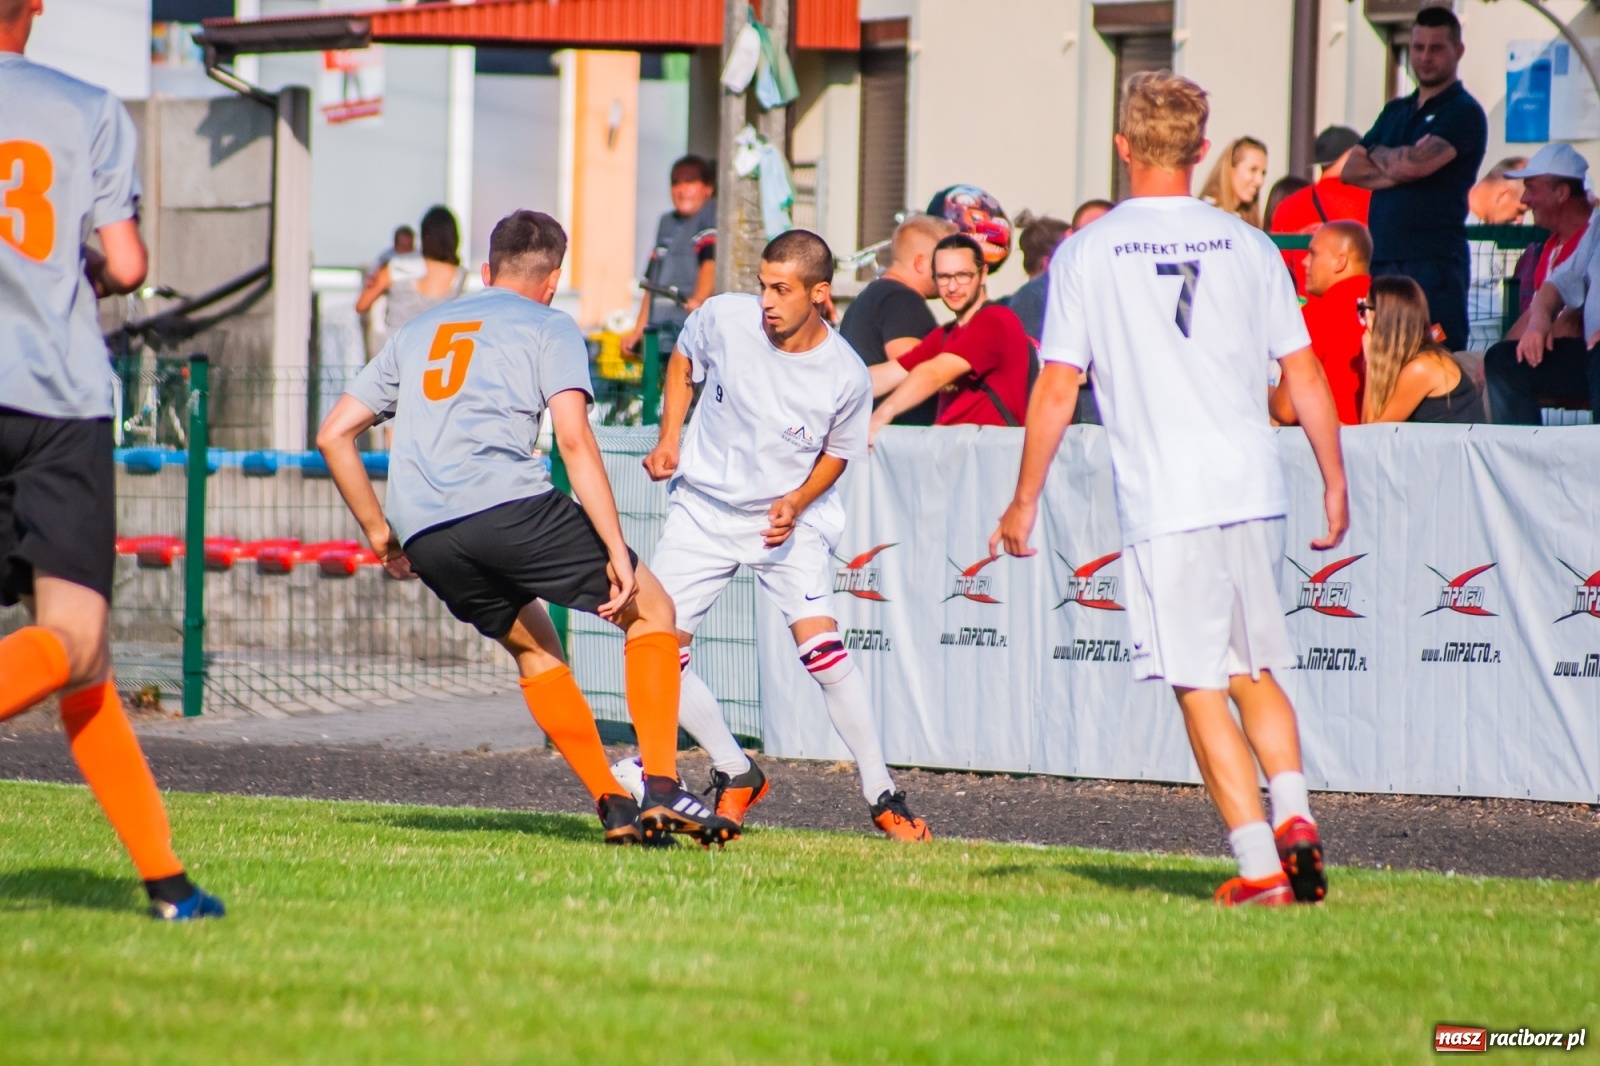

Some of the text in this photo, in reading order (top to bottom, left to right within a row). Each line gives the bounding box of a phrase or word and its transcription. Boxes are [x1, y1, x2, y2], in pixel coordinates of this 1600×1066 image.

[0, 139, 55, 262] 3
[1114, 239, 1233, 256] PERFEKT HOME
[1156, 260, 1201, 338] 7
[422, 320, 484, 401] 5
[715, 384, 723, 403] 9
